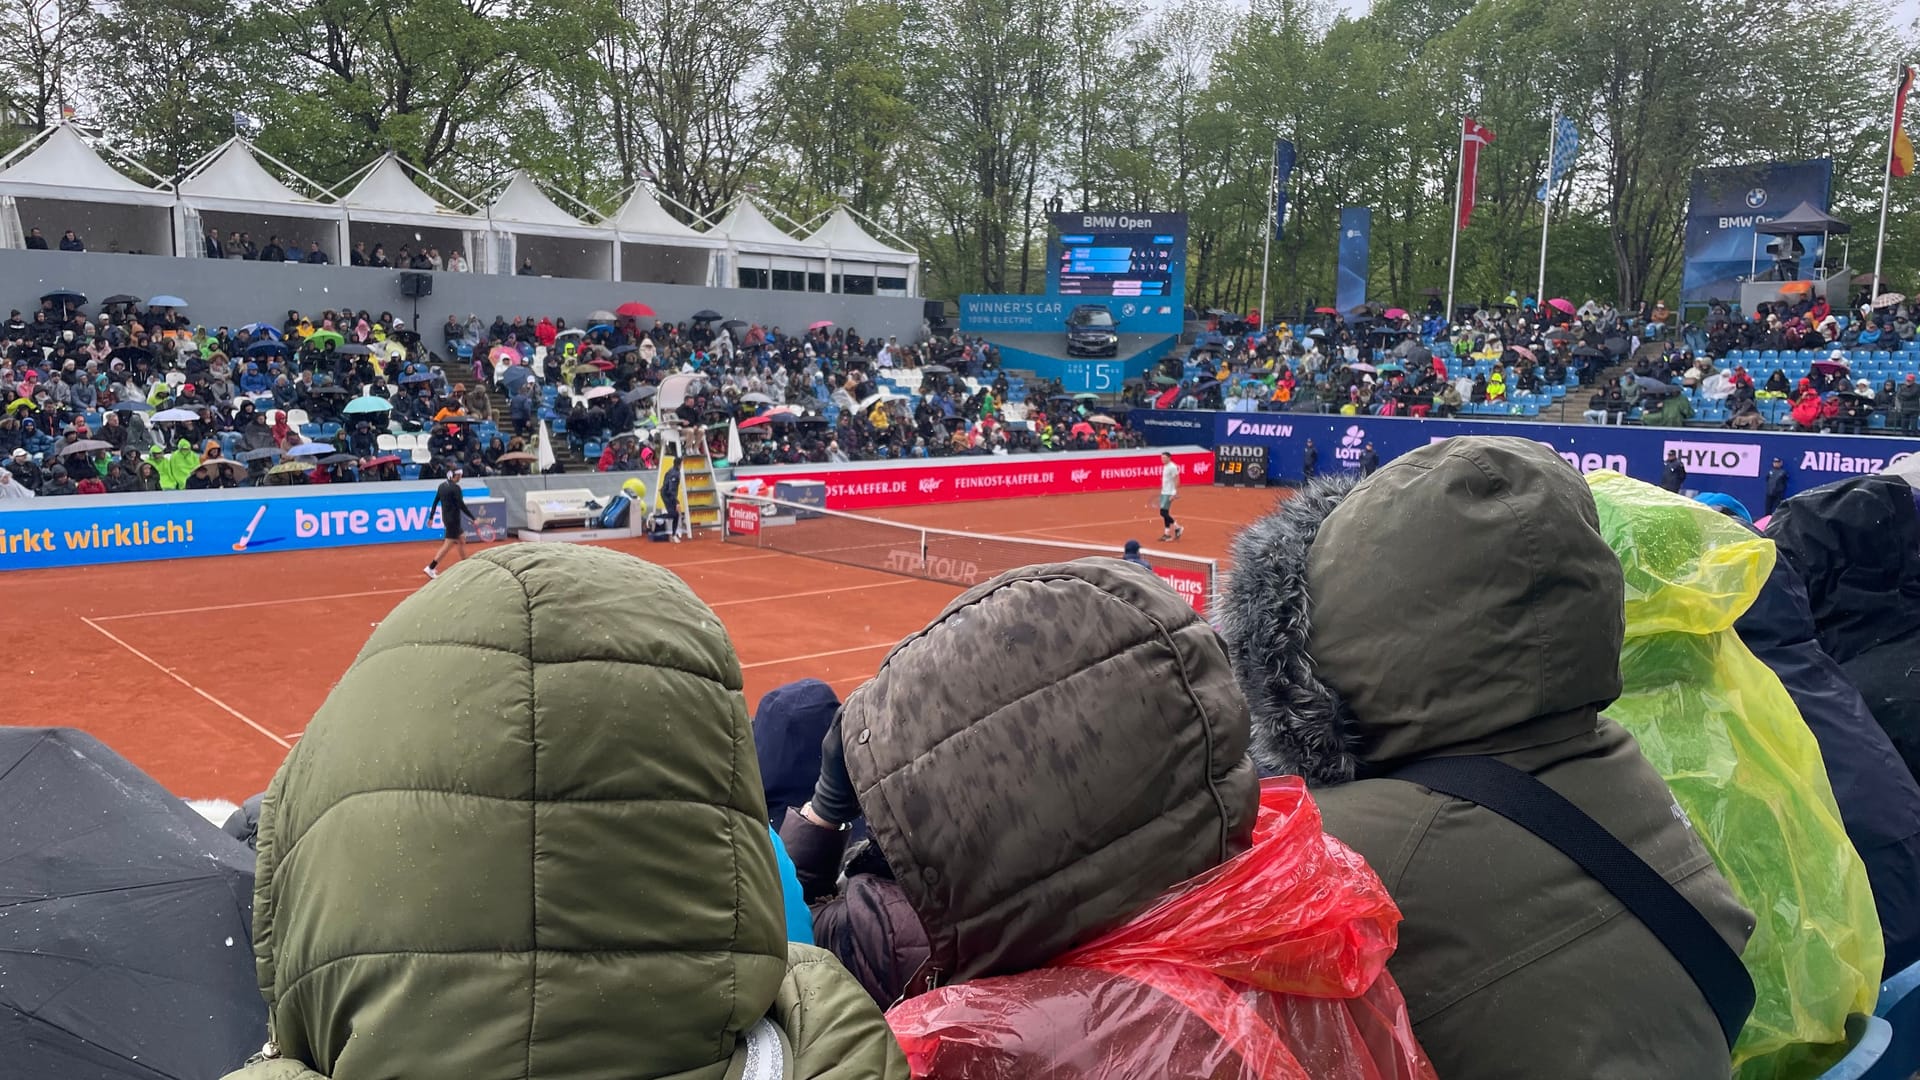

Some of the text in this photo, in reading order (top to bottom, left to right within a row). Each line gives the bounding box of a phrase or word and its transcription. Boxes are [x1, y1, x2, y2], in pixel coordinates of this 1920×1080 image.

[1083, 216, 1152, 230] BMW Open
[1719, 216, 1753, 228] BMW
[969, 302, 1062, 313] WINNER'S CAR
[1240, 423, 1293, 437] DAIKIN
[1219, 446, 1264, 457] RADO
[1335, 447, 1361, 460] LOTT
[1678, 449, 1740, 468] HYLO
[1800, 451, 1884, 474] Allianz
[955, 471, 1055, 489] FEINKOST-KAEFER.DE
[729, 506, 758, 521] Emirates
[64, 519, 194, 550] wirklich!
[884, 549, 978, 584] ATP TOUR
